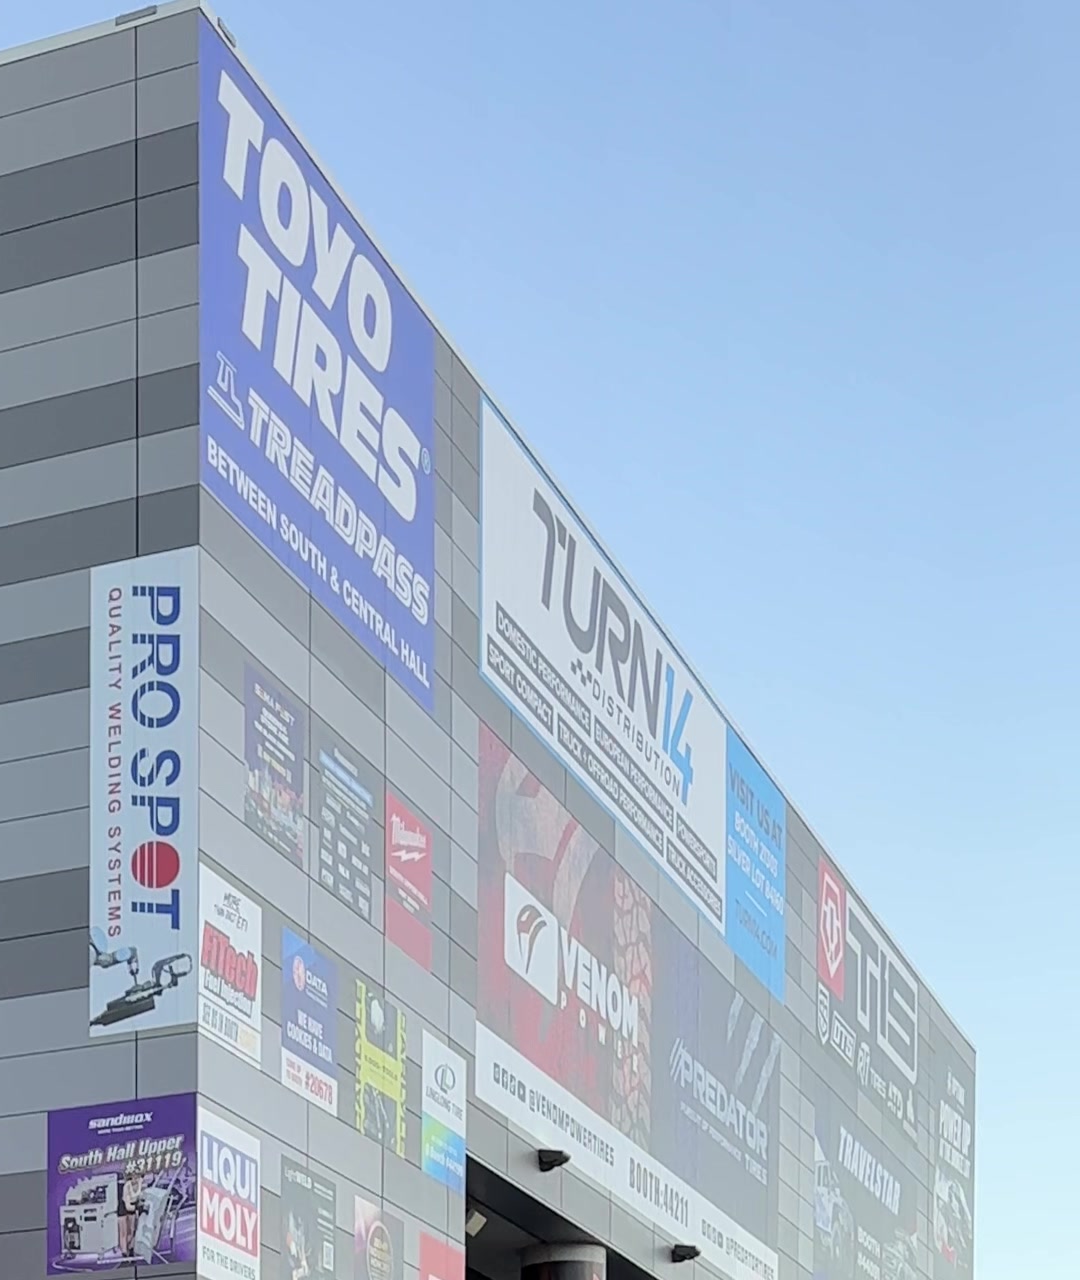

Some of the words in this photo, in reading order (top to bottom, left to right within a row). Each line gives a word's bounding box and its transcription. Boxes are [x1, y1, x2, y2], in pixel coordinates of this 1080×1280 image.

[218, 69, 393, 373] TOYO
[237, 223, 422, 523] TIRES
[248, 388, 430, 626] TREADPASS
[206, 435, 277, 531] BETWEEN
[280, 513, 327, 582] SOUTH
[330, 564, 340, 596] &
[343, 579, 399, 656] CENTRAL
[401, 635, 430, 689] HALL
[107, 586, 123, 690] QUALITY
[131, 585, 181, 728] PRO
[488, 642, 514, 686] SPORT
[497, 611, 538, 665] DOMESTIC
[538, 653, 591, 736] PERFORMANCE
[107, 702, 123, 814] WELDING
[592, 681, 682, 798] DISTRIBUTION
[594, 720, 631, 775] EUROPEAN
[729, 762, 754, 816] VISIT
[107, 825, 123, 938] SYSTEMS
[130, 747, 181, 930] SPOT
[286, 1020, 313, 1051] COOKIES
[306, 970, 329, 998] DATA
[560, 926, 638, 1047] VENOM
[59, 1150, 104, 1173] South
[106, 1143, 136, 1163] Hall
[137, 1134, 185, 1158] Upper
[202, 1134, 258, 1205] LIQUI
[628, 1156, 689, 1229] BOOTH:44211
[743, 1151, 768, 1186] TIRES
[838, 1124, 901, 1217] TRAVELSTAR
[202, 1187, 258, 1251] MOLY
